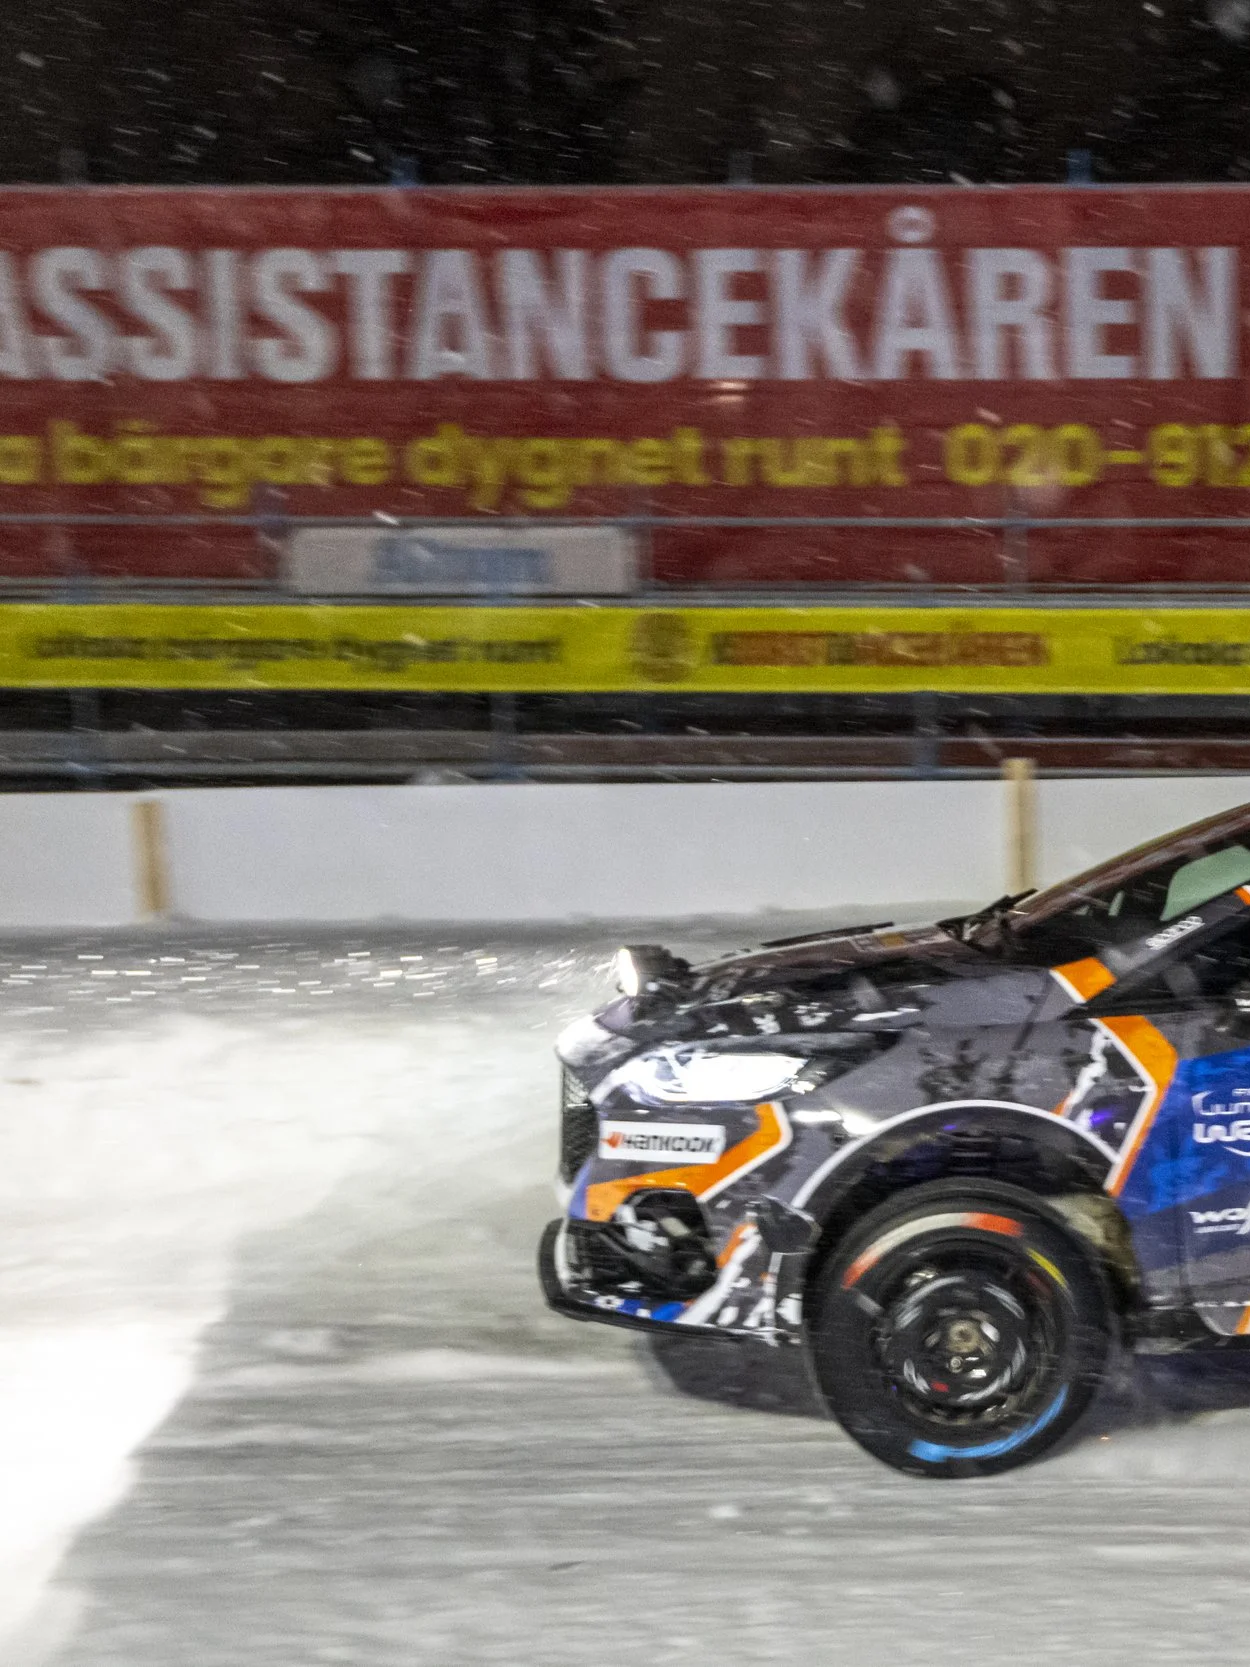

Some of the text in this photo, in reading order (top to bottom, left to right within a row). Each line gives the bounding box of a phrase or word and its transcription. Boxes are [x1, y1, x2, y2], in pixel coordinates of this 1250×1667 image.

[52, 418, 392, 507] bärgare
[408, 422, 708, 508] dygnet
[722, 432, 908, 487] runt
